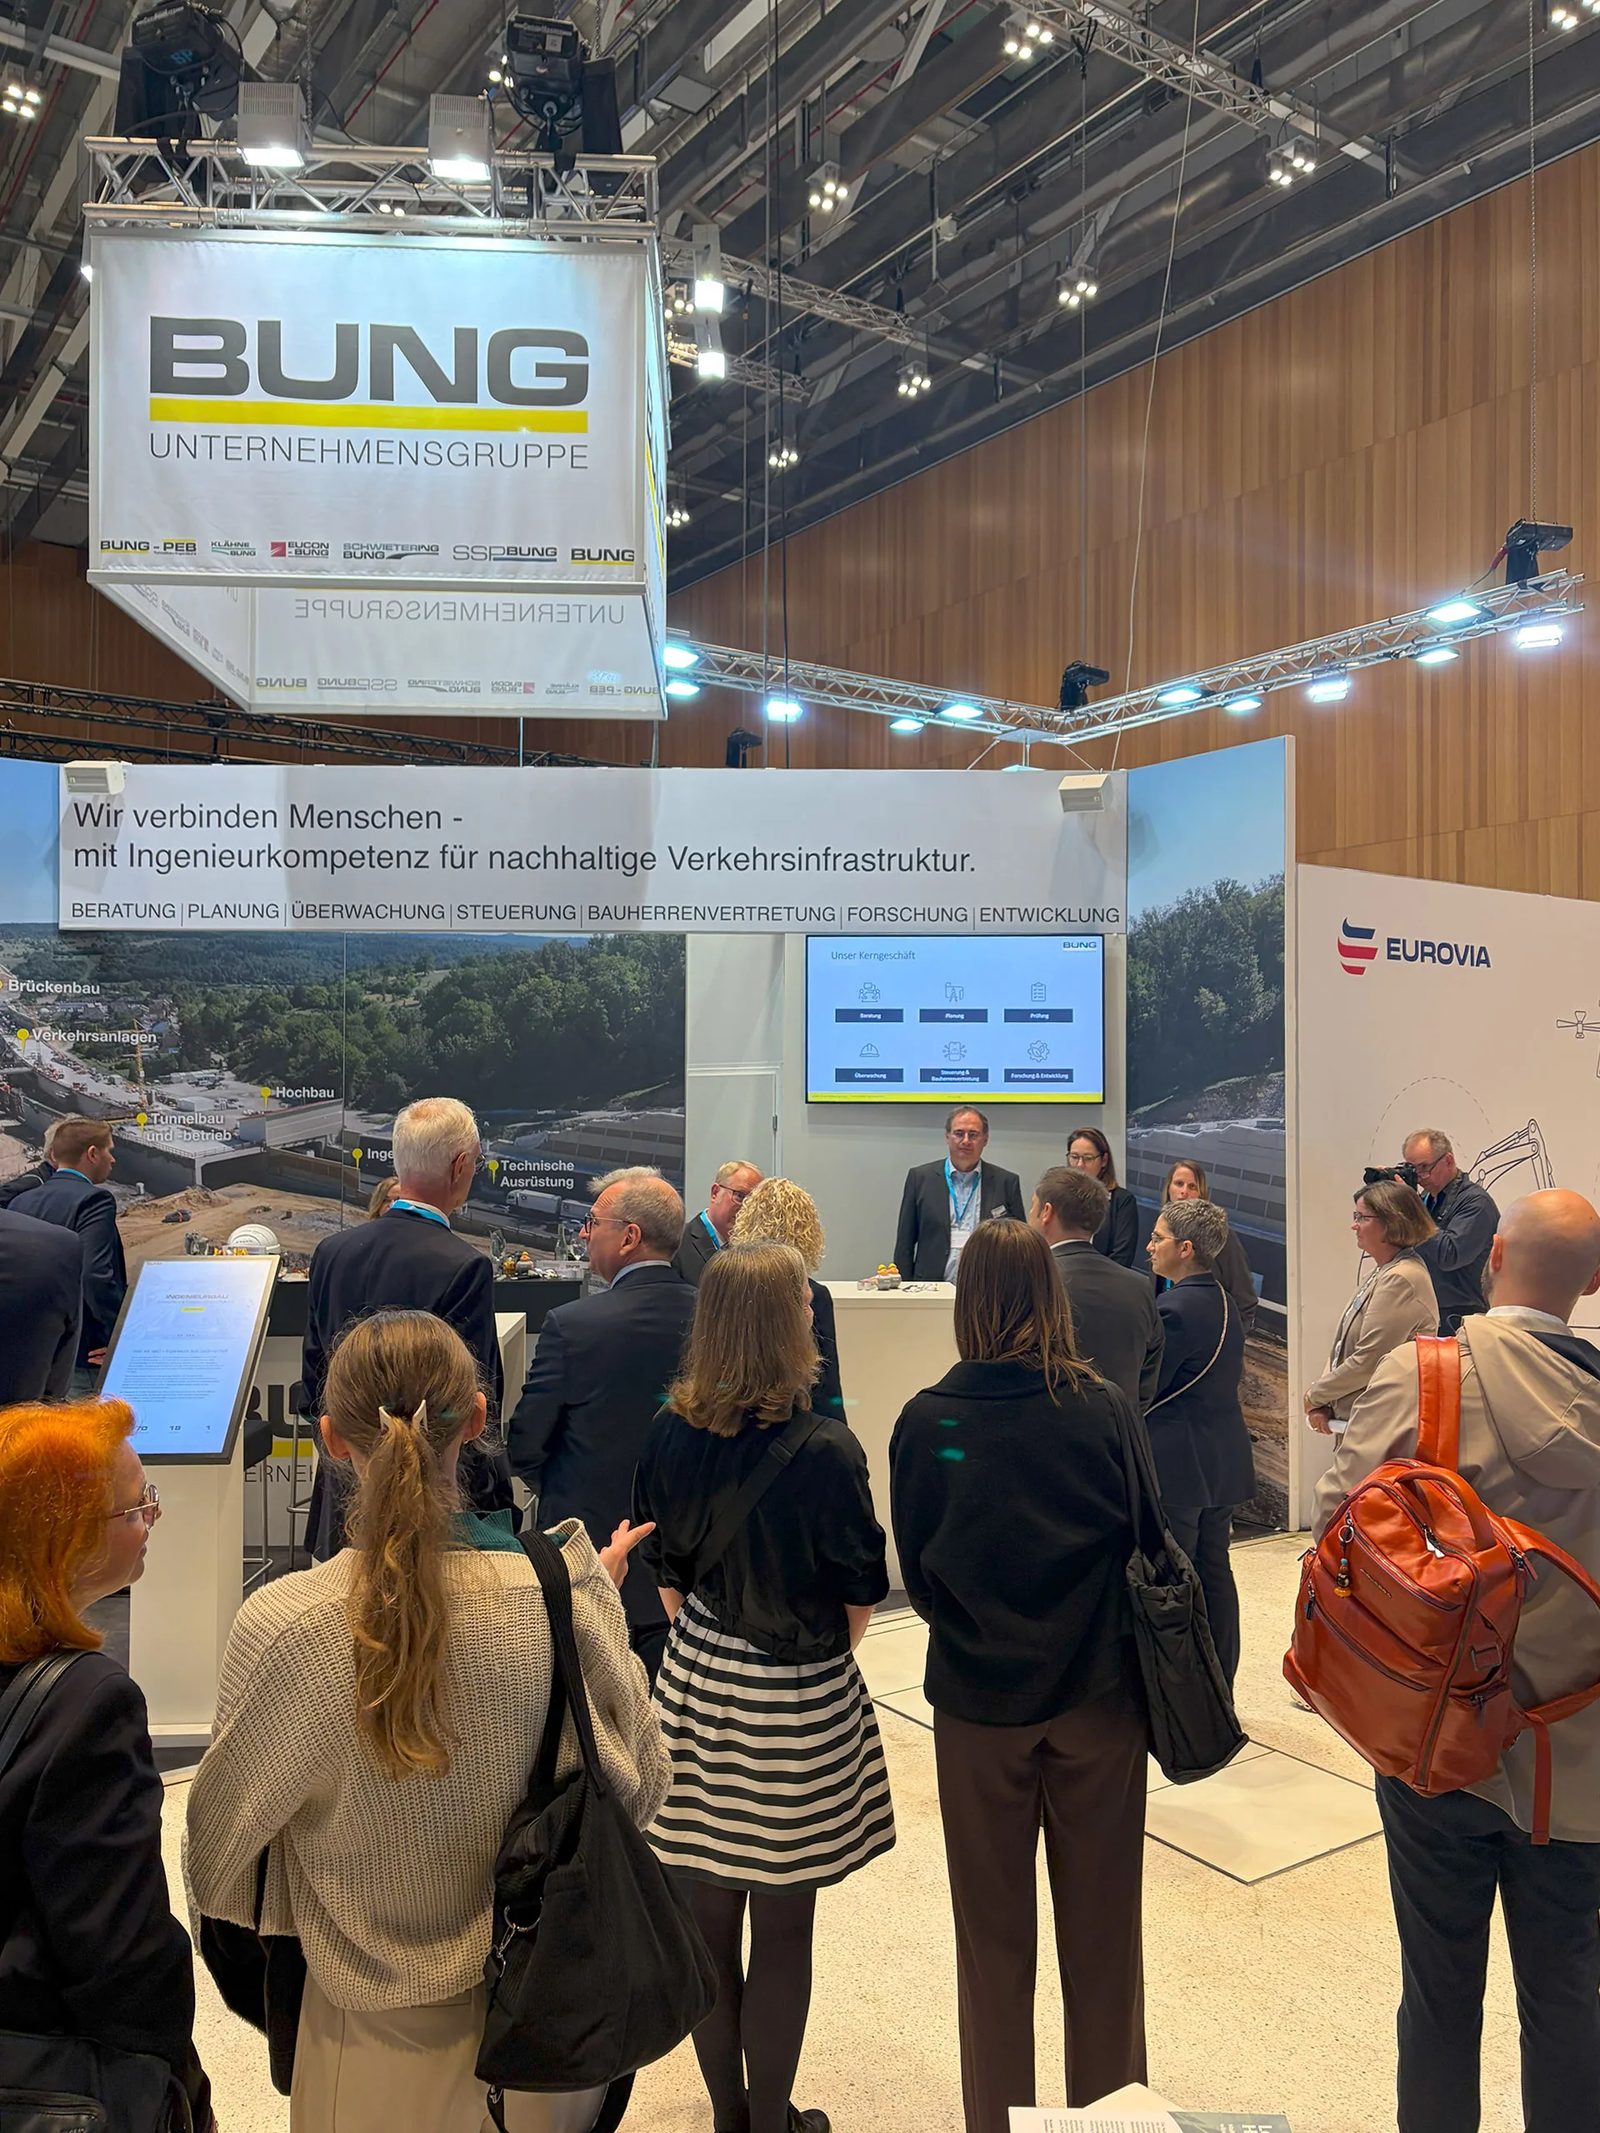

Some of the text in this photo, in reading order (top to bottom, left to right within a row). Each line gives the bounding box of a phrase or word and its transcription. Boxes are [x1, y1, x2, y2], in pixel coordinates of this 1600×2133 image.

[150, 315, 590, 407] BUNG
[150, 432, 589, 469] UNTERNEHMENSGRUPPE
[100, 540, 150, 551] BUNG
[163, 541, 197, 552] PEB
[288, 541, 329, 549] EUCON
[343, 543, 440, 552] SCHWIETERING
[295, 548, 329, 557] BUNG
[343, 550, 386, 560] BUNG
[570, 548, 635, 562] BUNG
[74, 802, 124, 828] Wir
[134, 803, 278, 829] verbinden
[290, 804, 442, 830] Menschen
[74, 842, 976, 877] mit Ingenieurkompetenz für nachhaltige Verkehrsinfrastruktur.
[71, 901, 1120, 923] BERATUNG PLANUNG ÜBERWACHUNG STEUERUNG BAUHERRENVERTRETUNG FORSCHUNG ENTWICKLUNG
[1063, 941, 1097, 949] BUNG
[831, 951, 915, 961] Unser Kerngeschäft
[1387, 937, 1491, 968] EUROVIA
[9, 979, 100, 995] Brückenbau
[33, 1028, 157, 1043] Verkehrsanlagen
[276, 1086, 335, 1099] Hochbau
[151, 1112, 224, 1125] Tunnelbau
[147, 1129, 232, 1142] und -betrieb
[502, 1160, 574, 1172] Technische
[501, 1176, 574, 1190] Ausrüstung
